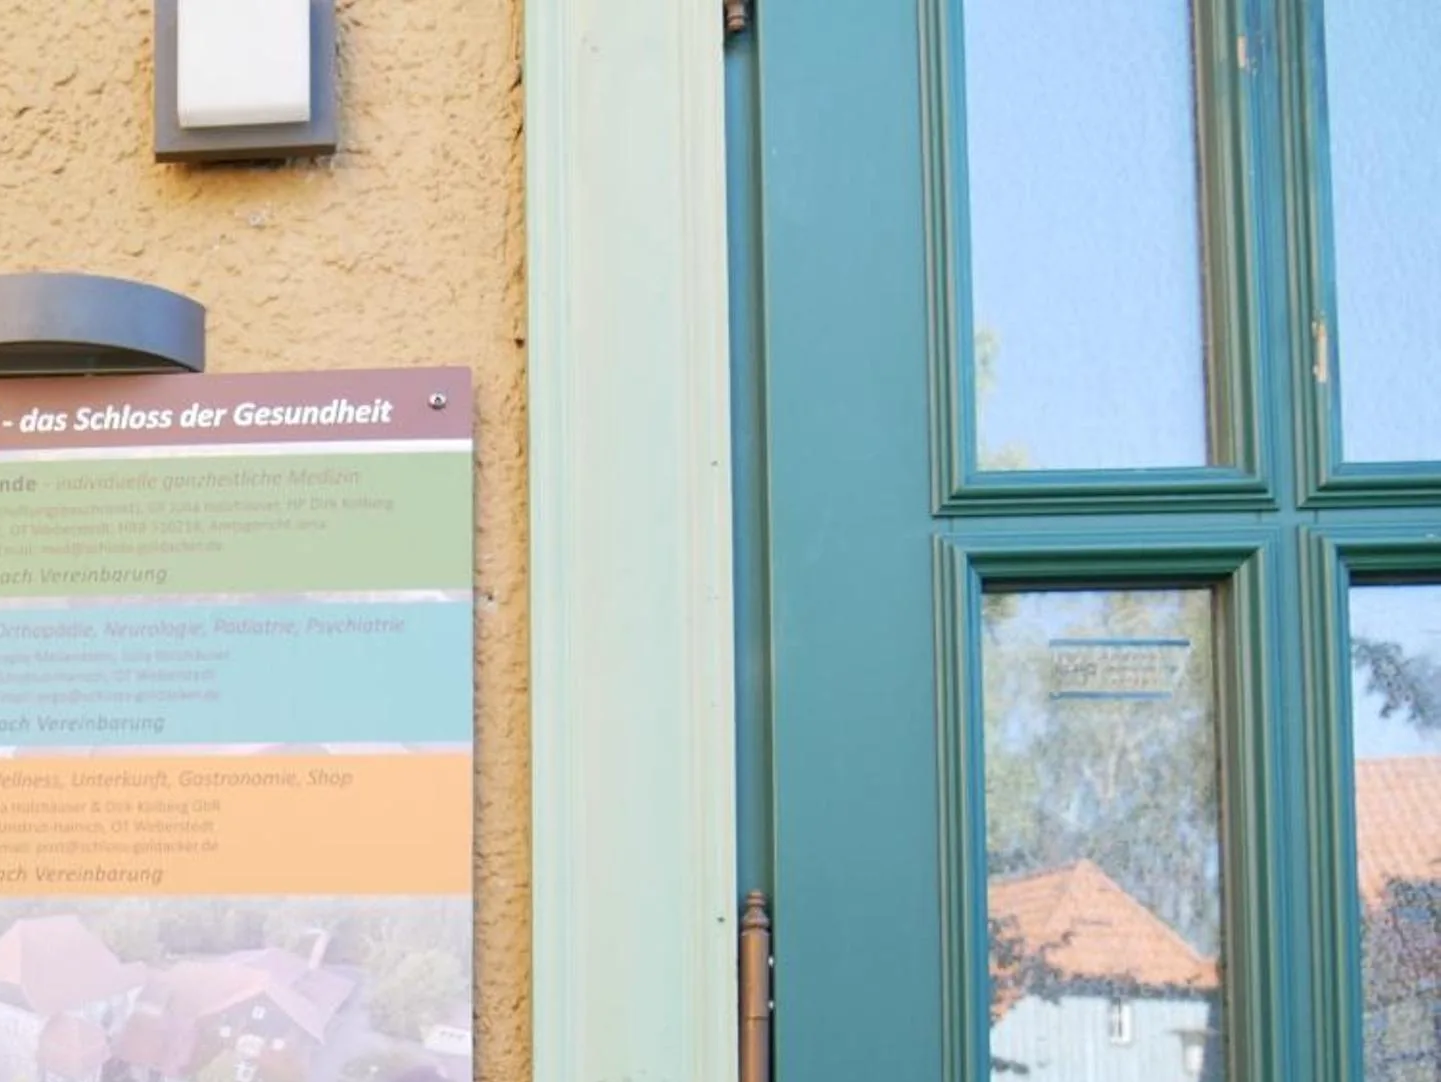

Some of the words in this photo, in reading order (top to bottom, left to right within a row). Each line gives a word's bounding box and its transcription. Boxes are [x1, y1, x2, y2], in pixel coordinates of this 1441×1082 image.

[20, 408, 68, 433] das
[73, 404, 173, 431] Schloss
[180, 402, 227, 428] der
[234, 398, 393, 427] Gesundheit
[39, 566, 169, 586] Vereinbarung
[36, 713, 166, 734] Vereinbarung
[305, 767, 355, 788] Shop
[35, 864, 165, 886] Vereinbarung
